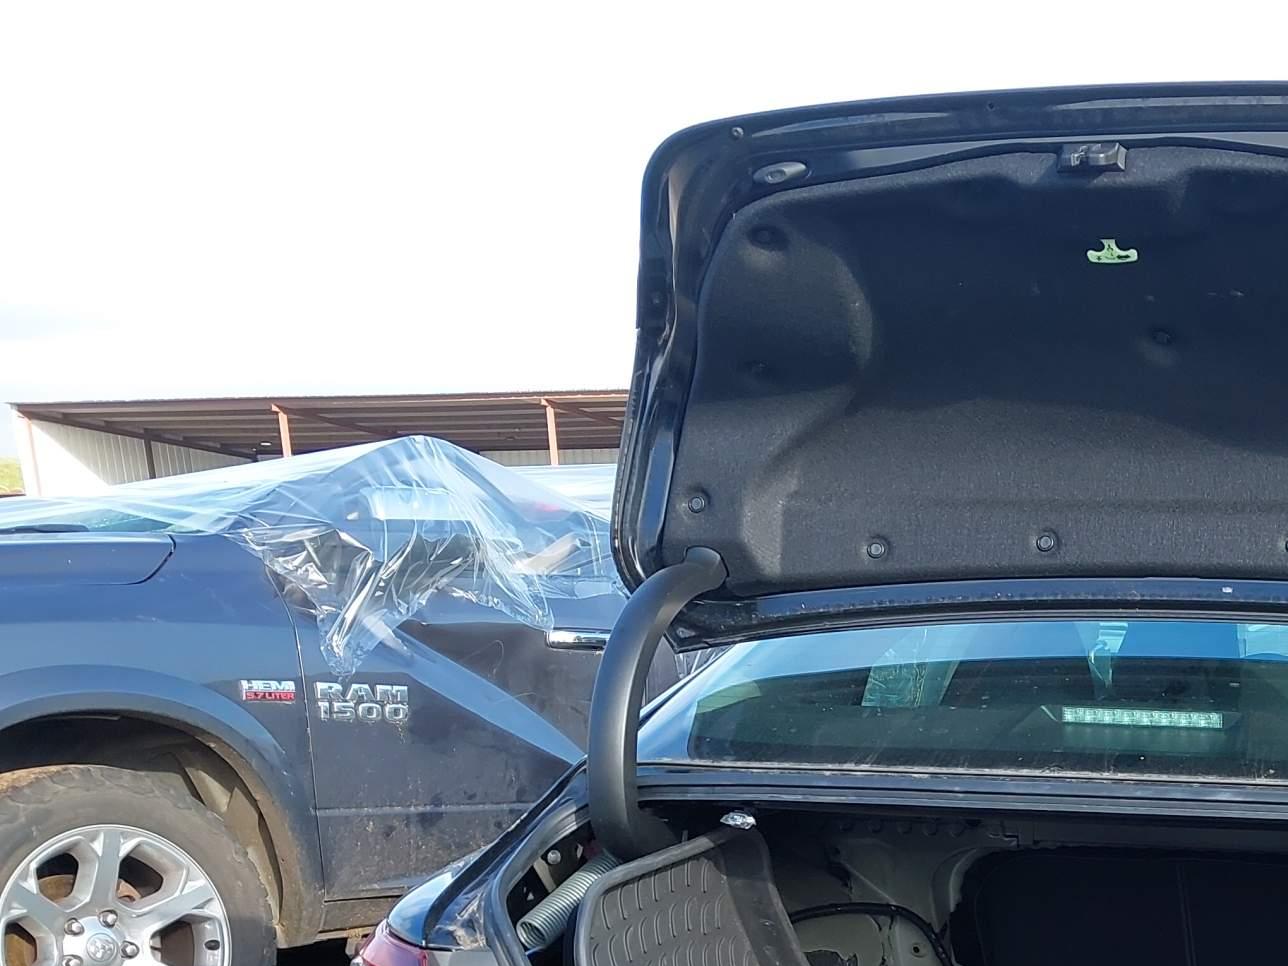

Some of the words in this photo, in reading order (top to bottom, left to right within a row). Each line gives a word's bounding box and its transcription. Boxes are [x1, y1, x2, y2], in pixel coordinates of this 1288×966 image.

[240, 680, 296, 692] HEMI
[313, 681, 409, 702] RAM
[266, 692, 295, 700] LITER
[317, 702, 409, 723] 1500
